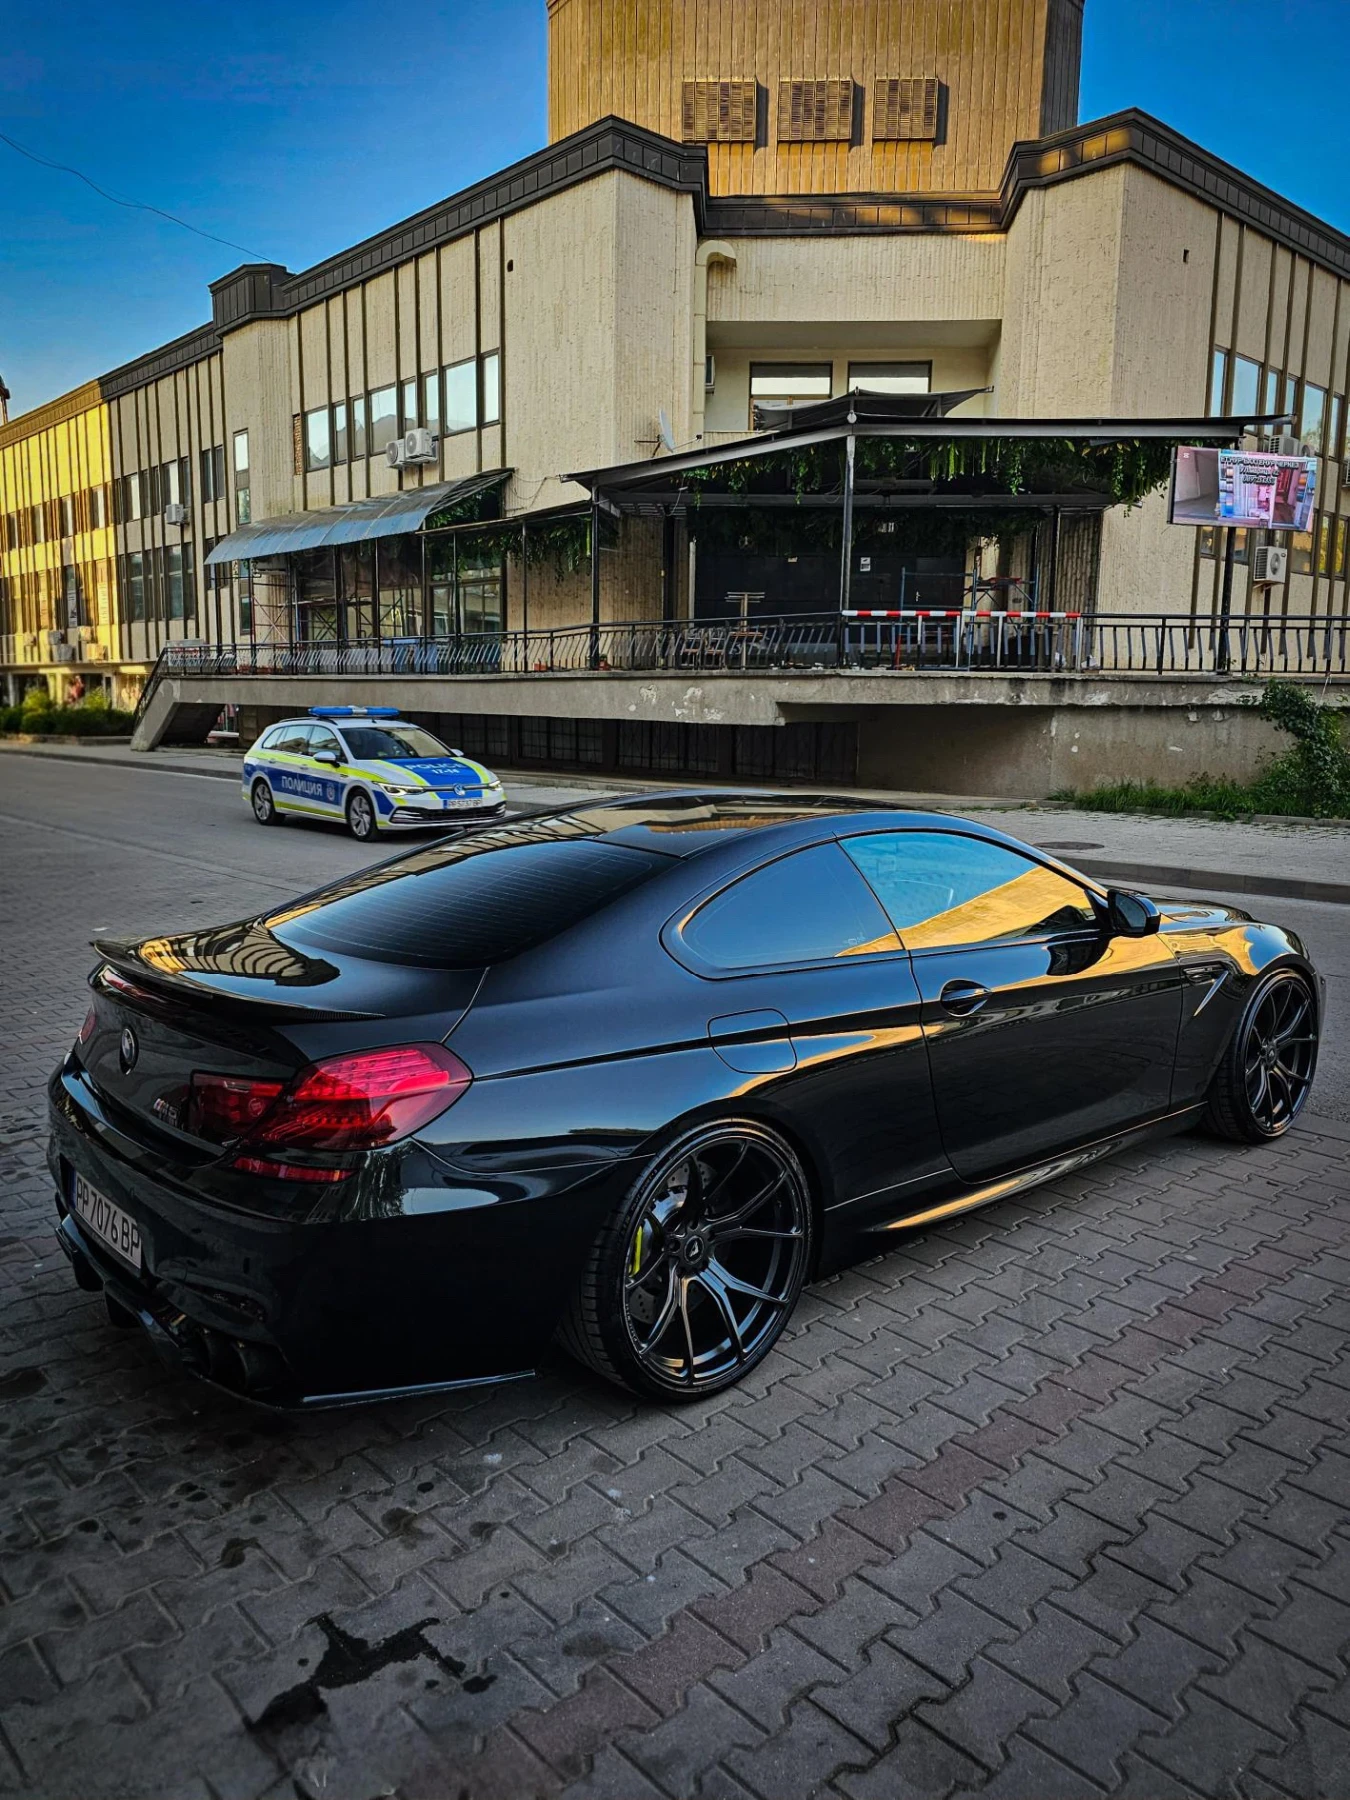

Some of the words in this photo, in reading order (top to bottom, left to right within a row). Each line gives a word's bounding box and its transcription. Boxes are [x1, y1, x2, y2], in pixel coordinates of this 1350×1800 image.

[281, 776, 323, 796] ПОЛИЦИЯ
[90, 1190, 119, 1244] 7076
[121, 1216, 140, 1257] BP
